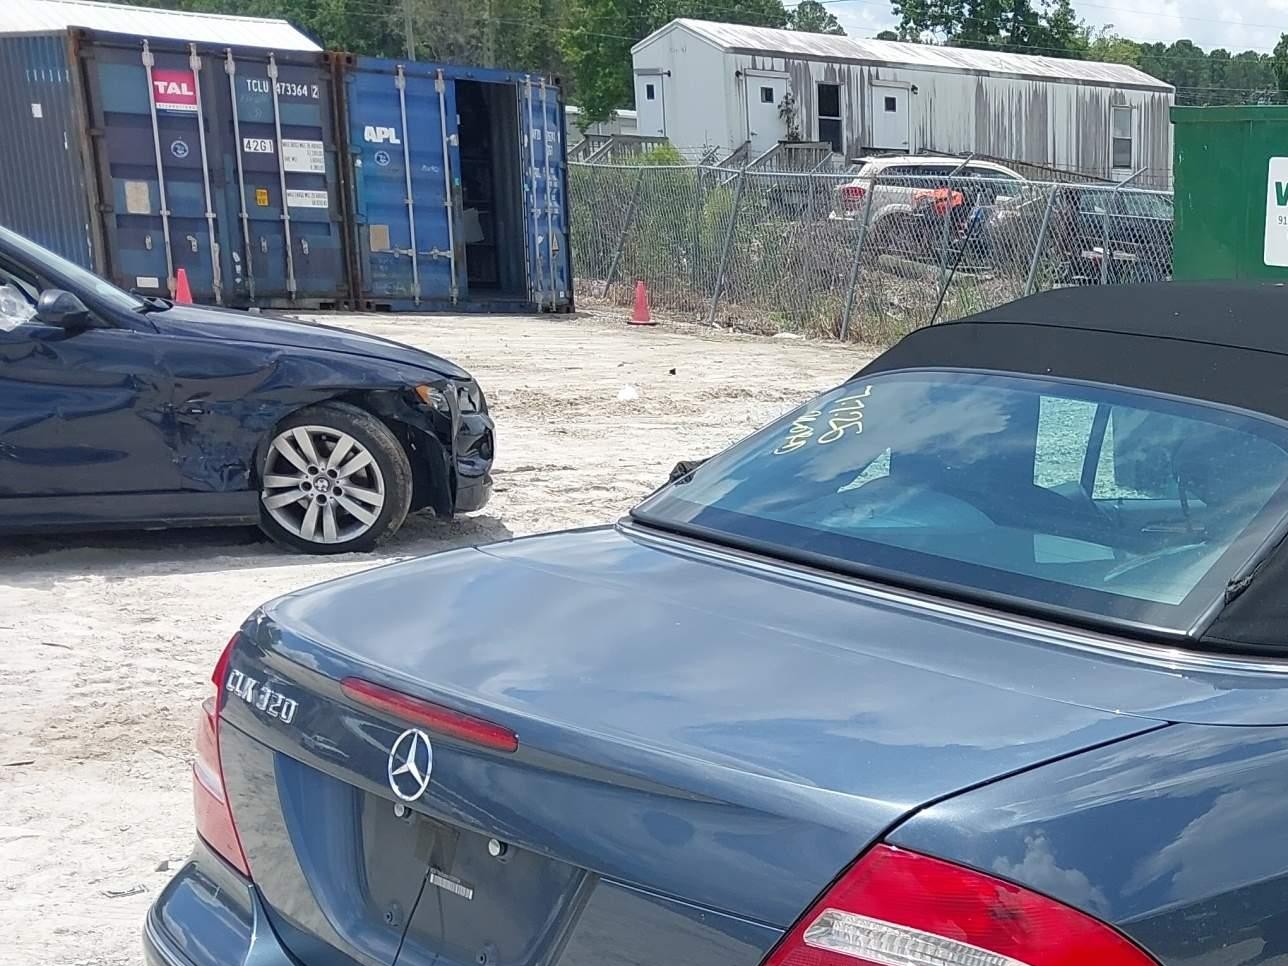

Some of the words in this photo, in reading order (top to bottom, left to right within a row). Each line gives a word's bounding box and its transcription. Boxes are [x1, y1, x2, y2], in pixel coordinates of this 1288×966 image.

[154, 80, 194, 96] TAL
[247, 79, 269, 93] TCLU
[276, 83, 308, 97] 473364
[311, 85, 320, 98] 2
[364, 126, 400, 144] APL
[245, 141, 273, 152] 42G1
[226, 668, 259, 703] CLK
[255, 686, 298, 724] 320
